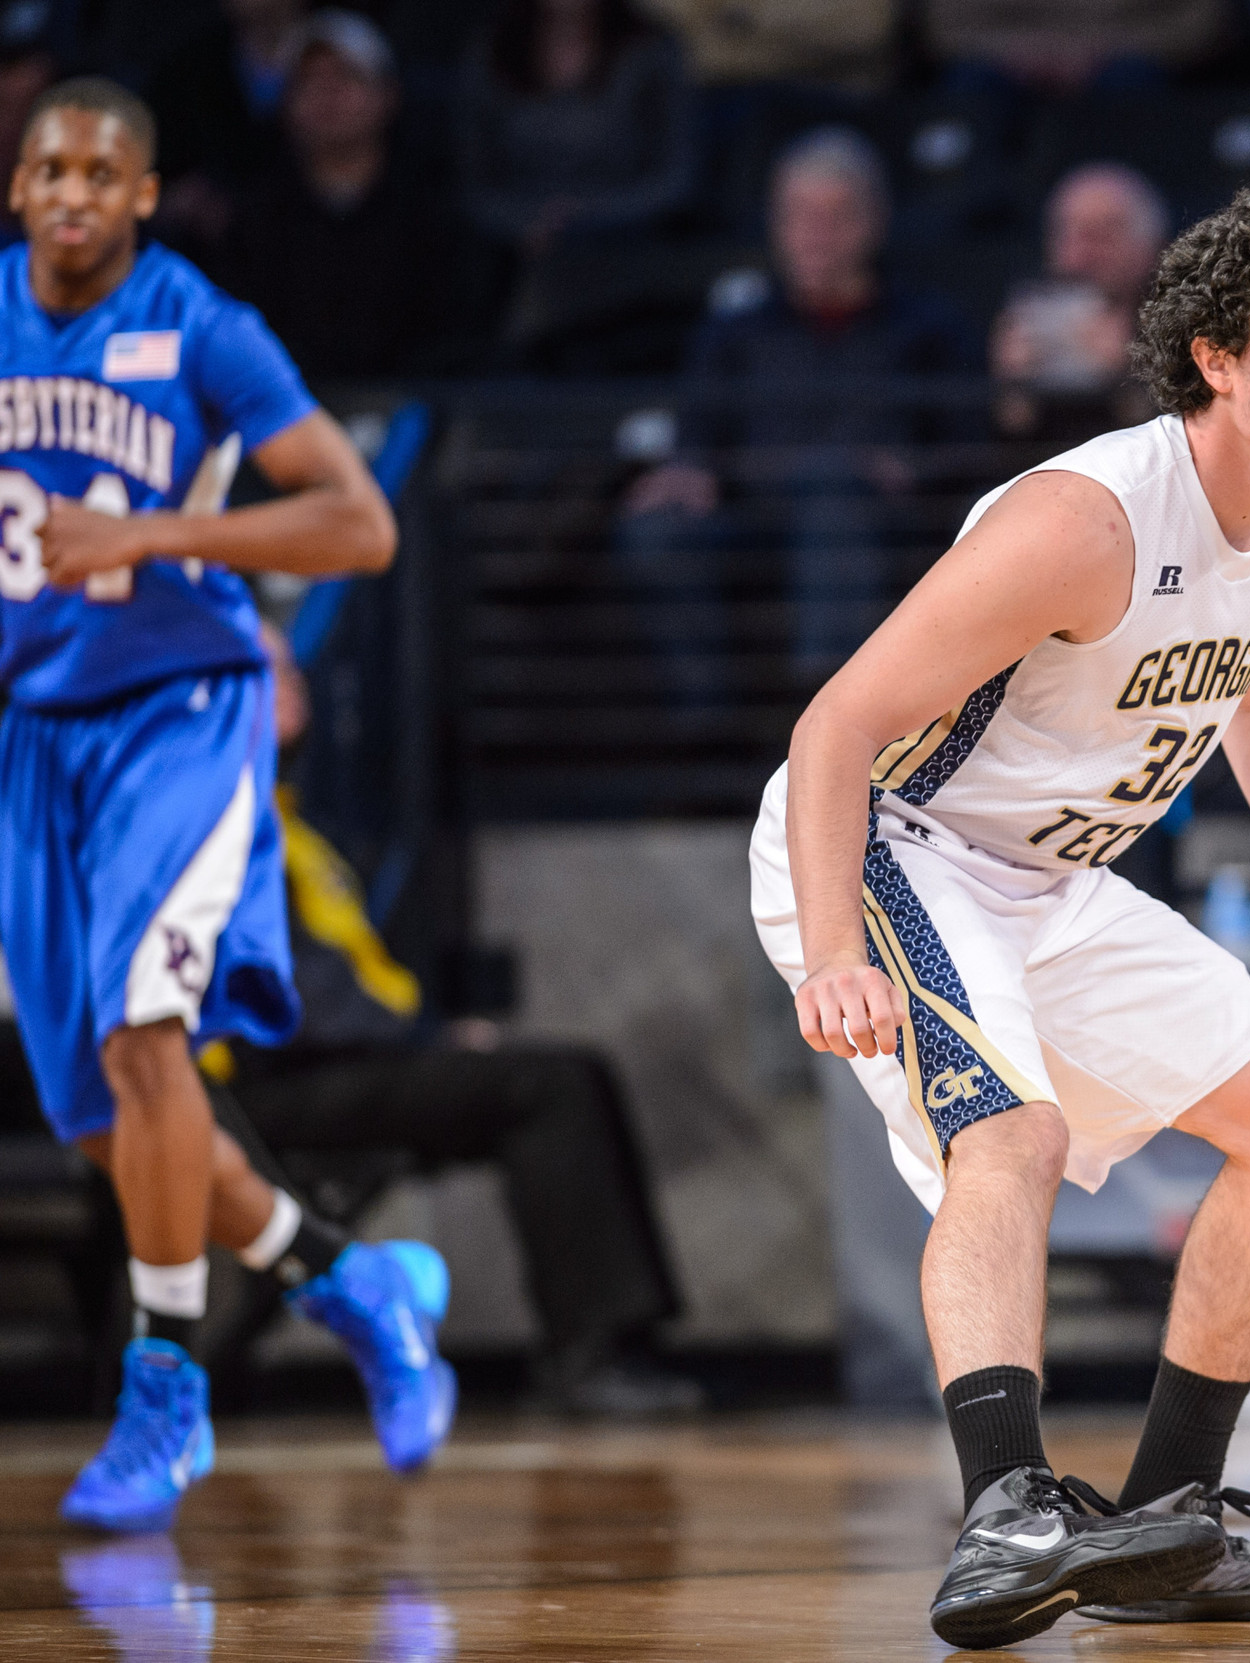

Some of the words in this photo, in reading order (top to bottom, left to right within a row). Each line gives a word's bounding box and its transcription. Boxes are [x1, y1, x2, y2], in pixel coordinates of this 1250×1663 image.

[1152, 587, 1184, 596] RUSSELL
[1158, 565, 1183, 587] R
[1104, 722, 1219, 806] 32
[927, 1065, 984, 1108] GT
